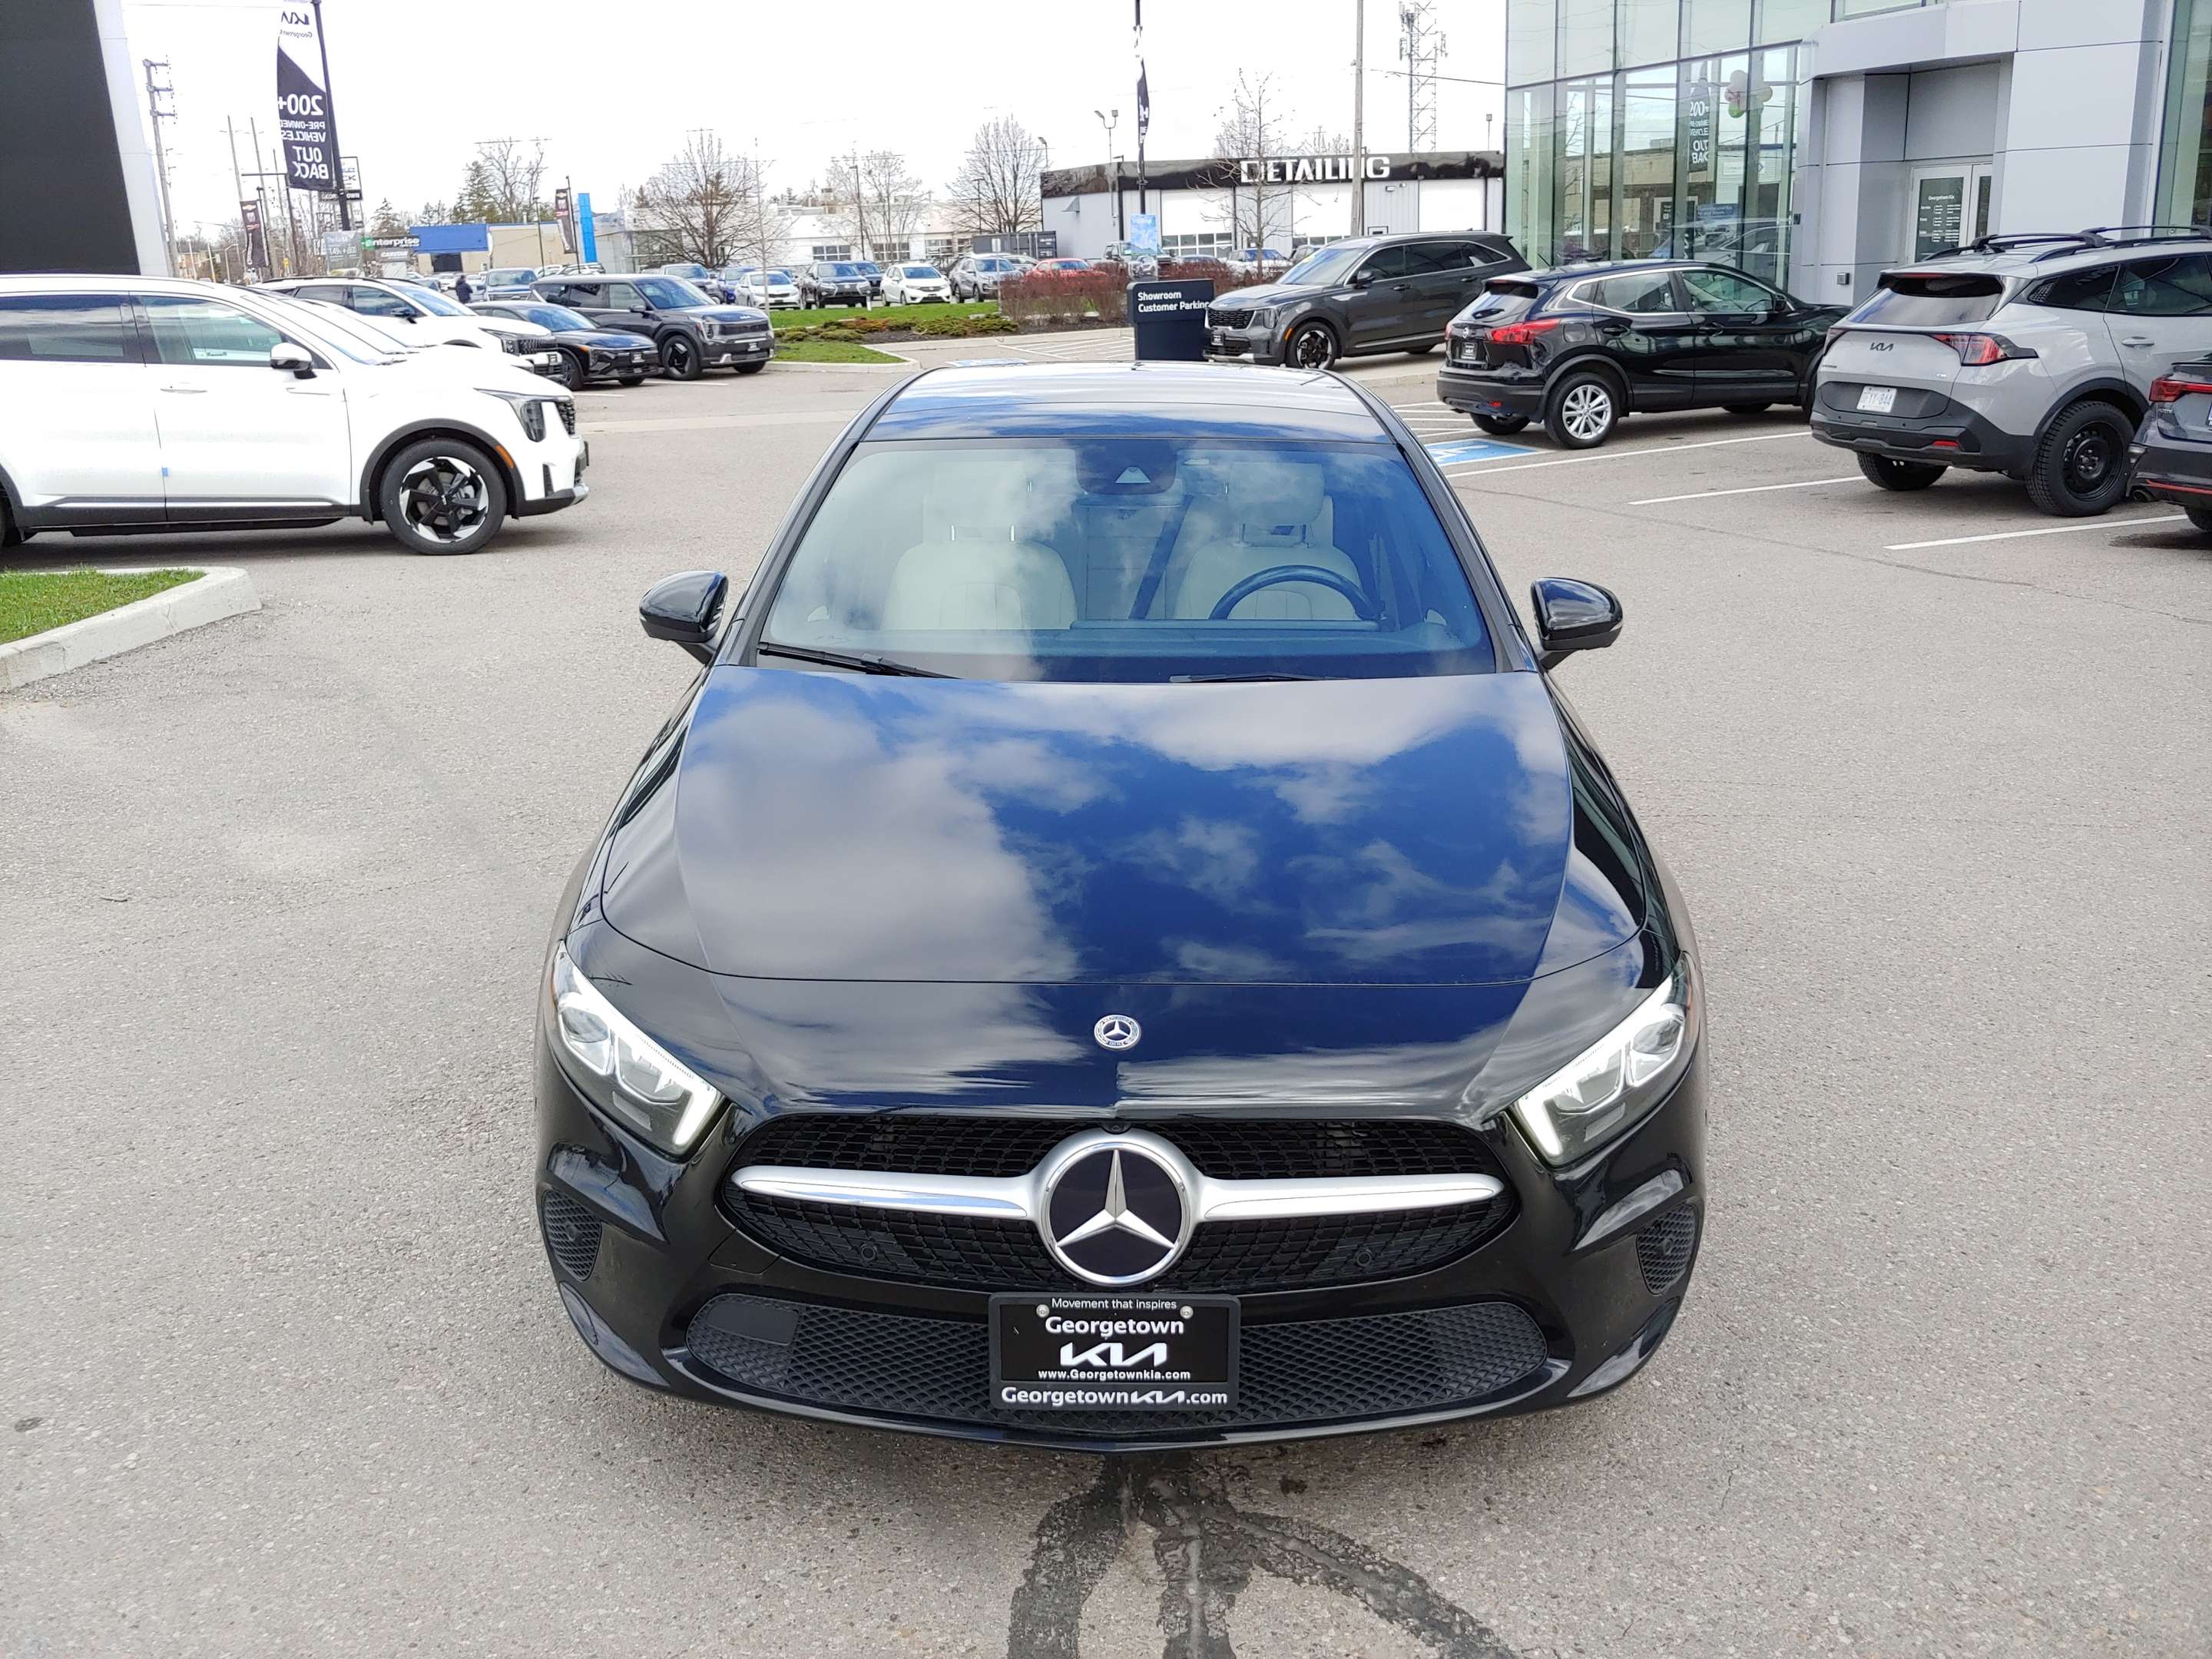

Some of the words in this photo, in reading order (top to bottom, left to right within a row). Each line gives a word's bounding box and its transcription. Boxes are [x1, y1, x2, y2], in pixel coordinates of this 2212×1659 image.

[365, 237, 420, 247] enterprise
[1137, 292, 1181, 301] Showroom
[1138, 303, 1177, 313] Customer
[1180, 300, 1210, 310] Parkin
[1051, 1297, 1109, 1309] Movement
[1111, 1298, 1133, 1309] that
[1136, 1298, 1177, 1310] inspires
[1045, 1316, 1184, 1337] Georgetown
[1060, 1343, 1167, 1367] KIA
[1038, 1369, 1191, 1381] www.Georgetownkia.com
